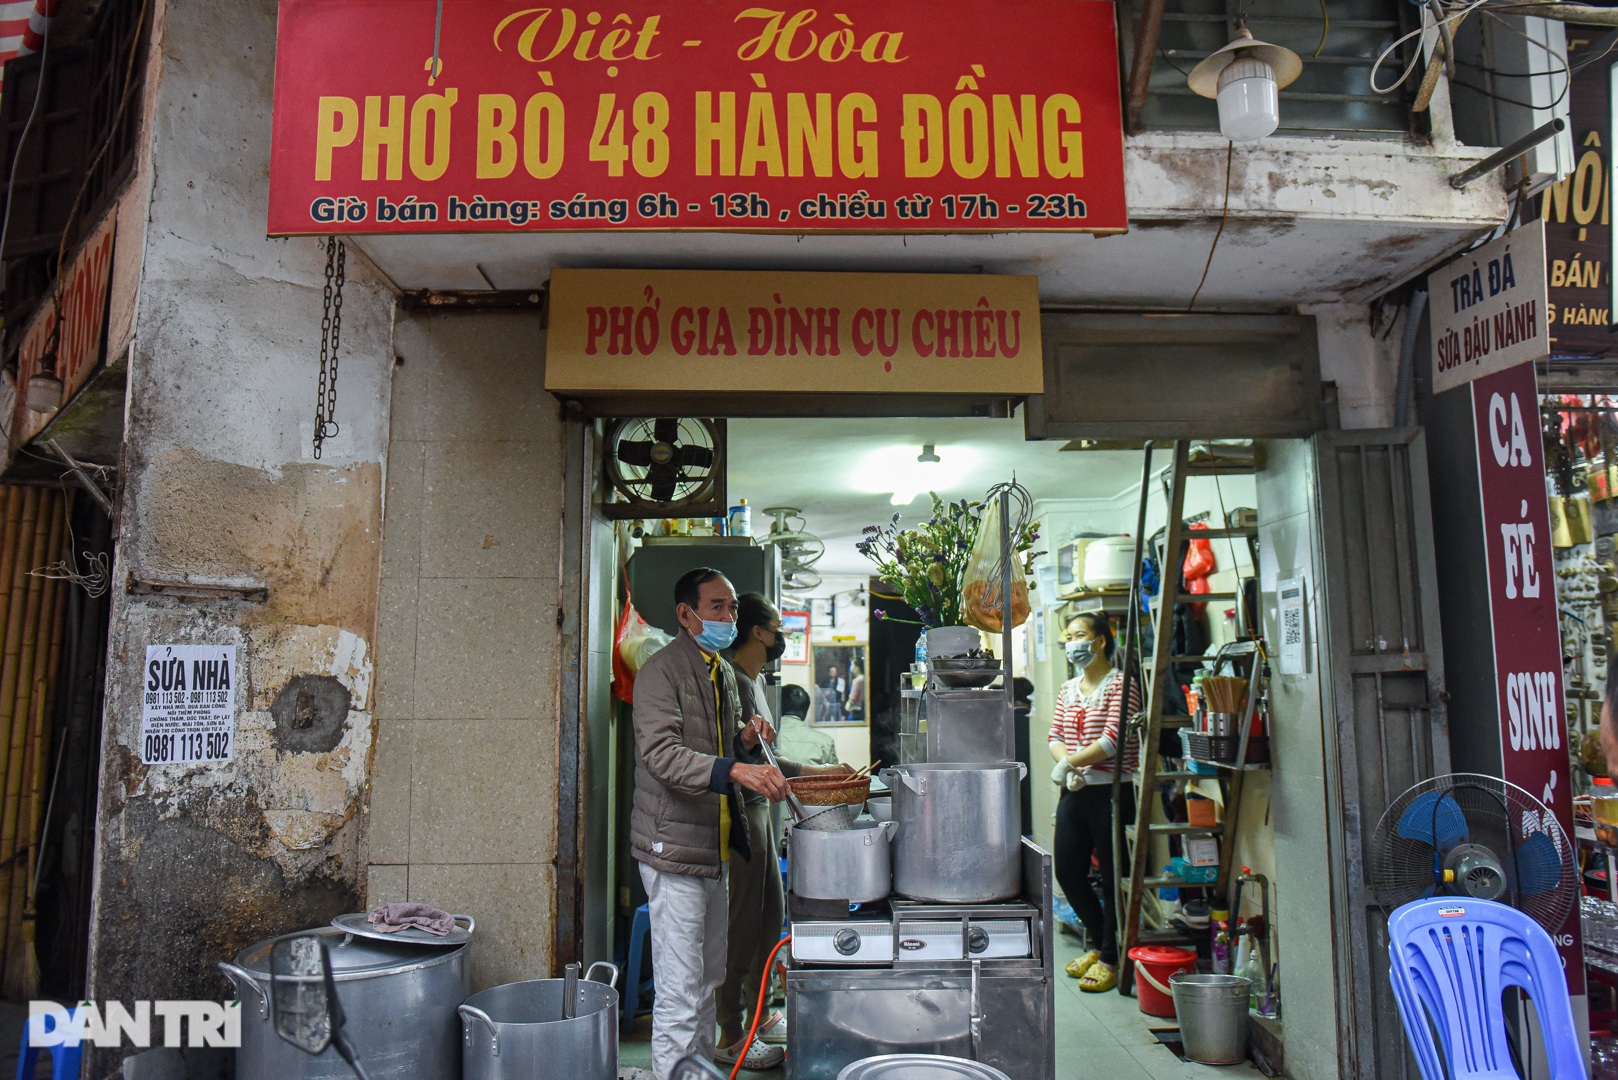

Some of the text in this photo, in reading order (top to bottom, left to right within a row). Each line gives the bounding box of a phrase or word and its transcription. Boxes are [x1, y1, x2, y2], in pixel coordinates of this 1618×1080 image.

[493, 8, 662, 78] Việt
[733, 8, 909, 63] Hòa
[315, 56, 1084, 181] PHỞ BÒ 48 HÀNG ĐỒNG
[310, 195, 366, 223] Giờ
[376, 195, 437, 222] bán
[448, 195, 540, 224] hàng:
[549, 192, 627, 223] sáng
[637, 193, 678, 217] 6h
[711, 193, 769, 218] 13h
[799, 191, 886, 219] chiều
[894, 192, 931, 218] từ
[941, 195, 998, 219] 17h
[1027, 194, 1087, 218] 23h
[1541, 130, 1609, 241] NỘ
[1451, 244, 1516, 314] TRÀ ĐÁ
[1551, 252, 1601, 288] BÁN
[585, 284, 1021, 372] PHỞ GIA ĐÌNH CỤ CHIÊU
[1464, 315, 1490, 365] ĐẬU
[1494, 299, 1537, 351] NÀNH
[1488, 392, 1532, 468] CA
[1501, 499, 1540, 599] FÉ
[146, 692, 160, 704] 0981
[162, 692, 173, 704] 113
[174, 692, 185, 703] 502
[206, 692, 216, 703] 113
[217, 691, 228, 703] 502
[148, 646, 230, 692] SỬA NHÀ
[1507, 672, 1560, 751] SINH
[145, 732, 228, 762] 0981 113 502
